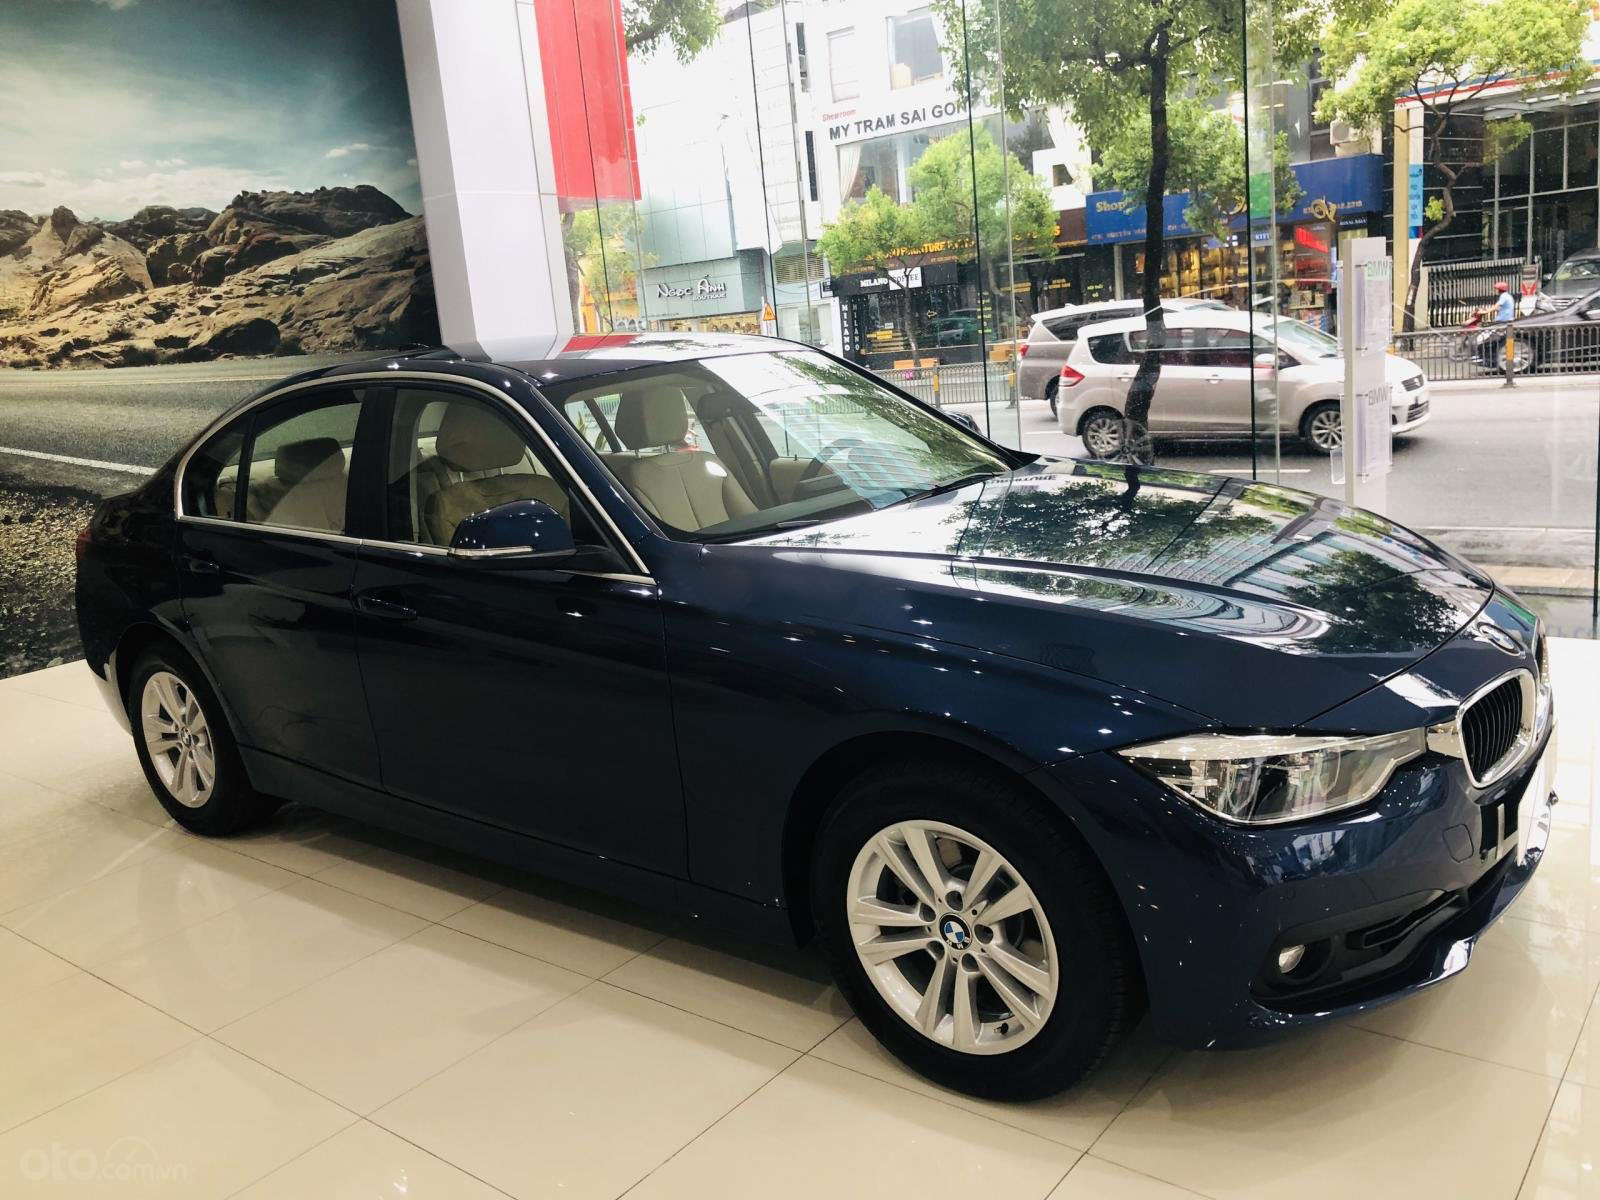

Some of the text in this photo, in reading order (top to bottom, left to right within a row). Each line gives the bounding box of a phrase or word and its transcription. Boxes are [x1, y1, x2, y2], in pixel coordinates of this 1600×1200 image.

[829, 101, 969, 141] MY TRAM SAI GON
[860, 273, 919, 288] MILANO COFEE
[841, 304, 850, 351] MILANO
[1368, 385, 1388, 406] BMW
